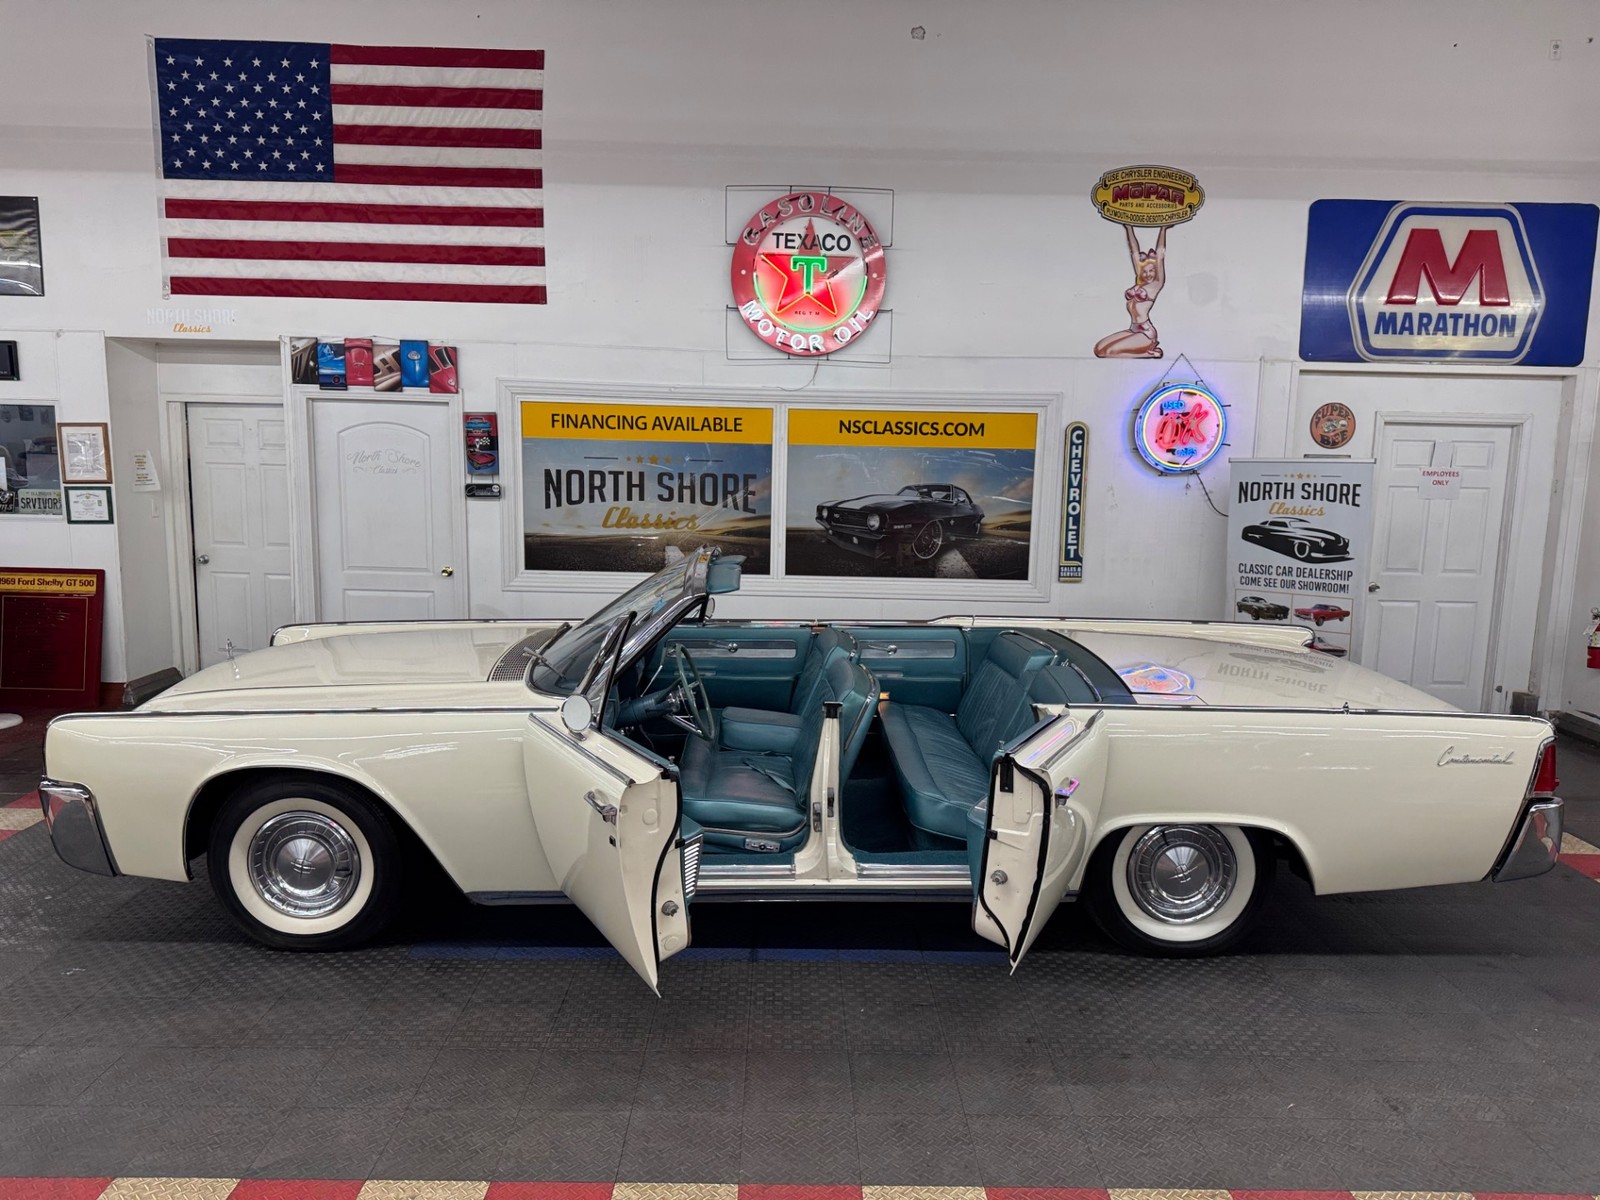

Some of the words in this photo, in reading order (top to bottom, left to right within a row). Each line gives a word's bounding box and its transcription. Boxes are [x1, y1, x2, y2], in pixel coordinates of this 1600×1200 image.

[1107, 173, 1119, 182] USE
[1120, 169, 1152, 180] CHRYSLER
[1153, 169, 1190, 184] ENGINEERED
[743, 193, 878, 252] GASOLINE
[772, 232, 851, 251] TEXACO
[791, 255, 827, 295] T
[1384, 228, 1511, 306] M
[173, 322, 212, 333] Classics
[743, 300, 825, 353] MOTOR
[834, 310, 873, 345] OIL
[1374, 312, 1517, 337] MARATHON
[551, 413, 647, 431] FINANCING
[651, 416, 743, 432] AVAILABLE
[1315, 404, 1351, 428] SUPER
[839, 420, 985, 437] NSCLASSICS.COM
[1319, 430, 1349, 446] BEE
[1422, 470, 1460, 478] EMPLOYEES
[544, 468, 645, 509] NORTH
[657, 472, 757, 514] SHORE
[1067, 430, 1083, 558] CHEVROLET
[1238, 482, 1295, 503] NORTH
[1301, 482, 1361, 507] SHORE
[602, 506, 699, 530] Classics
[1268, 502, 1326, 516] Classics
[1238, 563, 1273, 576] CLASSIC
[1275, 565, 1293, 577] CAR
[1295, 567, 1353, 581] DEALERSHIP
[18, 578, 35, 586] Ford
[37, 578, 64, 588] Shelby
[66, 579, 78, 587] GT
[79, 579, 95, 587] 500
[1240, 576, 1261, 586] COME
[1263, 577, 1278, 588] SEE
[1280, 578, 1296, 589] OUR
[1297, 580, 1350, 594] SHOWROOM!
